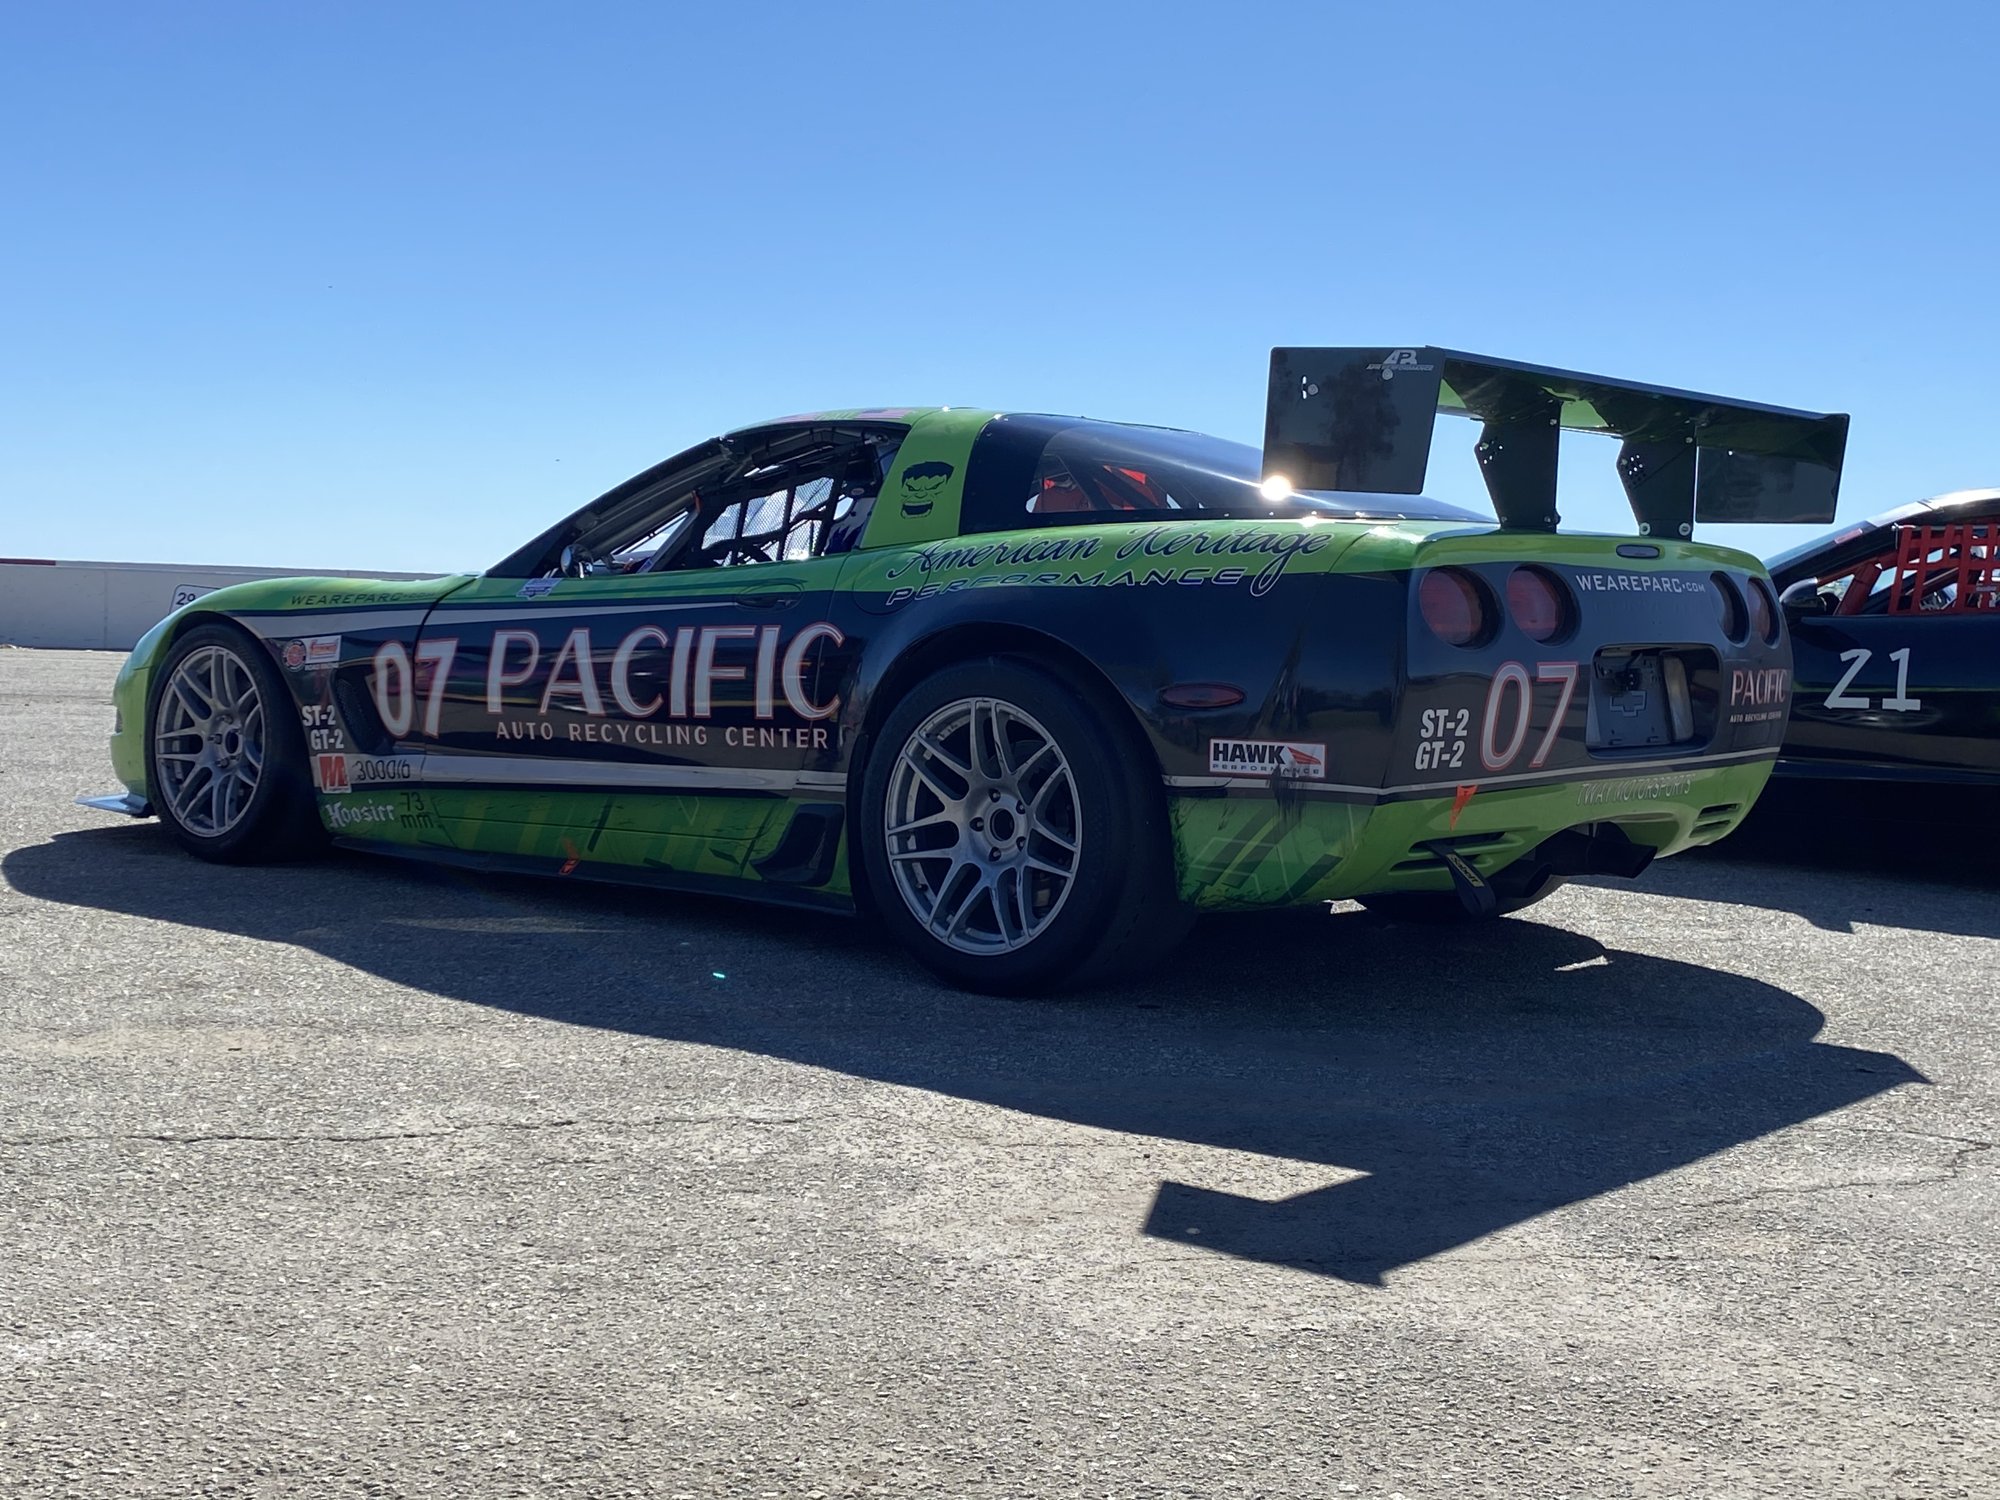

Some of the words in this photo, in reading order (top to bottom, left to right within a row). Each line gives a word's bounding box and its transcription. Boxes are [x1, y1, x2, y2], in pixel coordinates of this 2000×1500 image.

[887, 536, 1101, 579] American
[1116, 523, 1333, 597] Heritage
[886, 566, 1247, 606] PERFORMANCE
[373, 637, 459, 739] 07
[486, 622, 846, 721] PACIFIC
[1730, 667, 1788, 706] PACIFIC
[301, 704, 337, 727] ST-2
[1420, 708, 1470, 739] ST-2
[1480, 660, 1579, 771] 07
[310, 729, 344, 750] GT-2
[496, 721, 554, 741] AUTO
[568, 723, 707, 746] RECYCLING
[725, 726, 828, 749] CENTER
[1212, 742, 1286, 765] HAWK
[1414, 740, 1466, 770] GT-2
